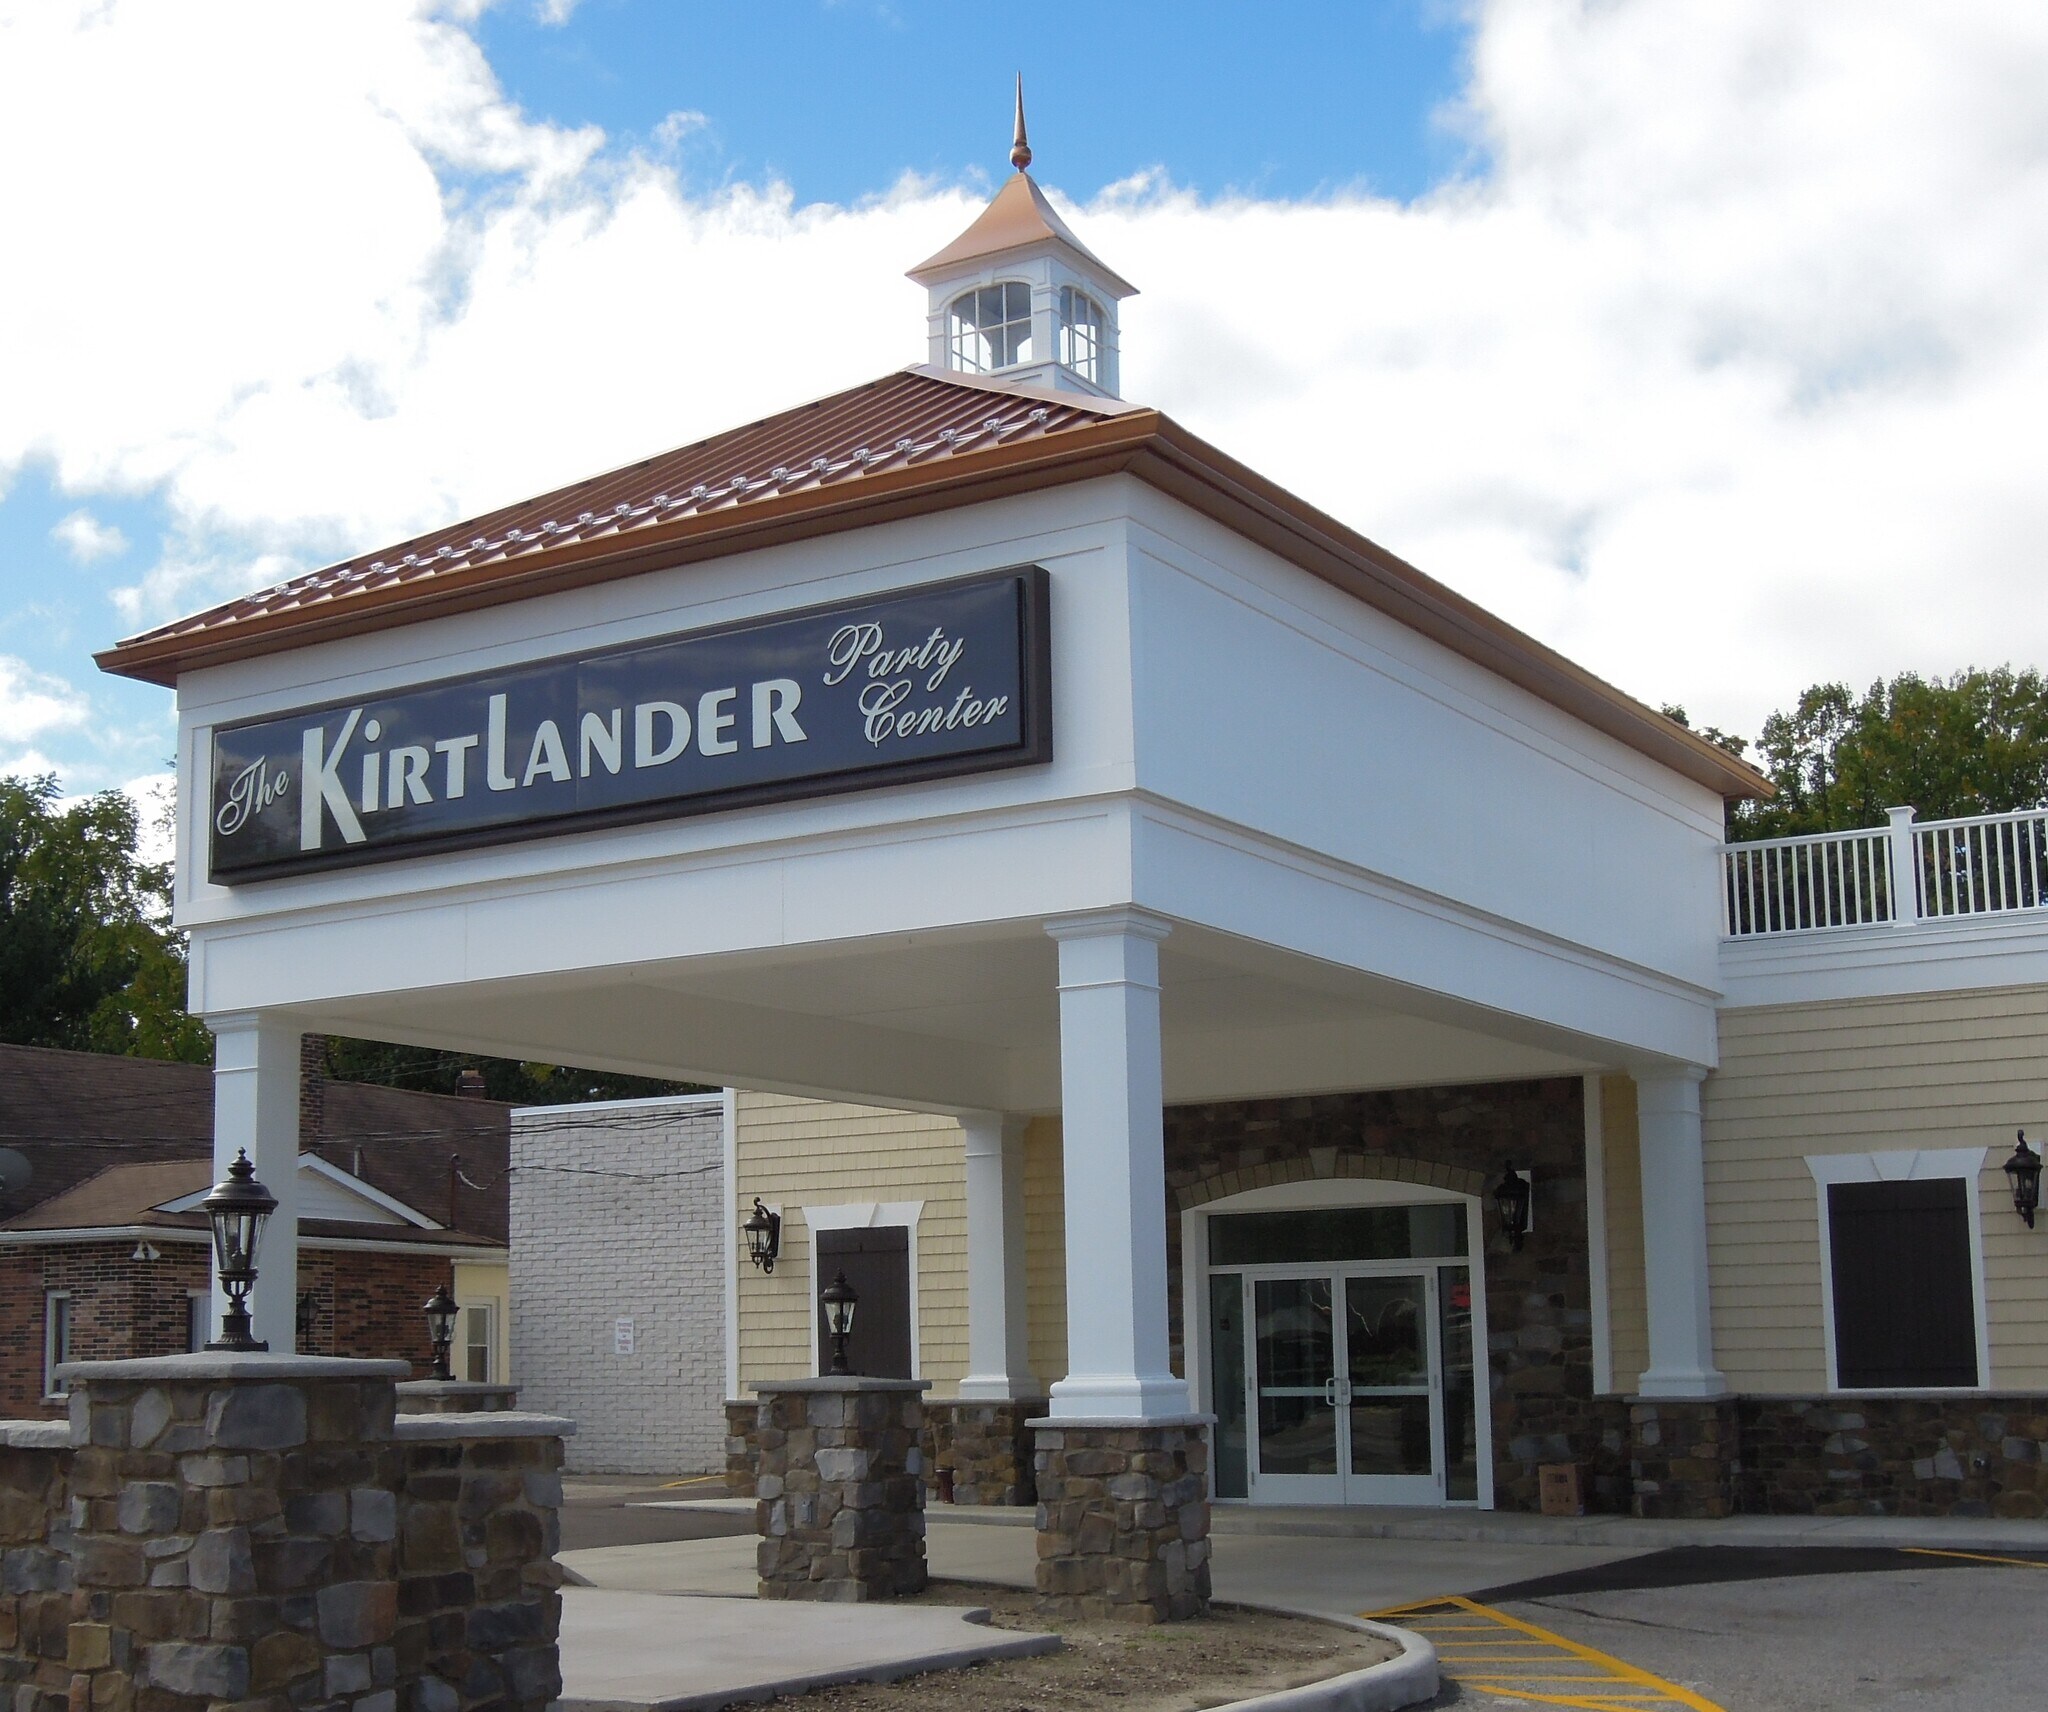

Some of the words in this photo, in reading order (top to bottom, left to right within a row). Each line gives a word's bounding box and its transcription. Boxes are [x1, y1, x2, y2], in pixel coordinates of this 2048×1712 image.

[823, 621, 964, 690] Party
[858, 680, 1009, 748] Center
[216, 755, 290, 836] The
